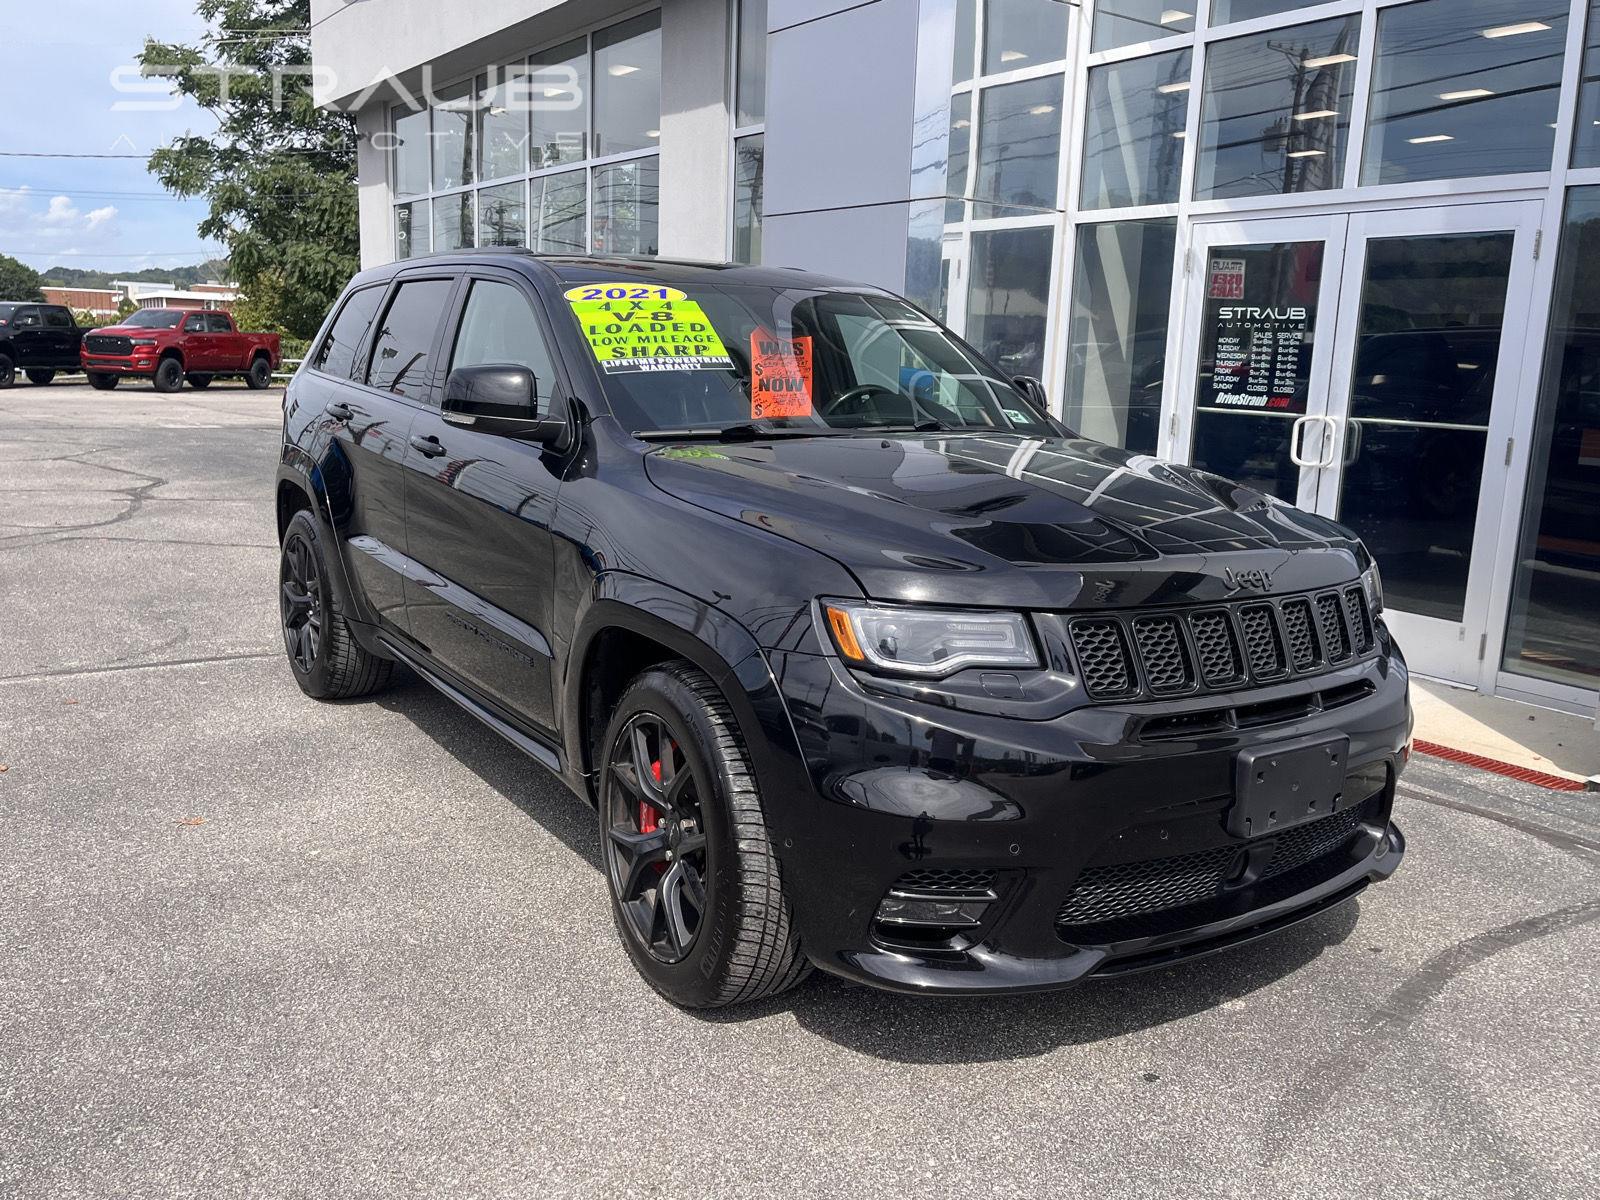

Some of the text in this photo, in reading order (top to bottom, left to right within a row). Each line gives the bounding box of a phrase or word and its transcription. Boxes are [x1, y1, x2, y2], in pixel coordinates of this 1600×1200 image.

[582, 288, 668, 300] 2021
[613, 312, 673, 322] V-8
[1219, 308, 1306, 320] STRAUB
[589, 323, 706, 336] LOADED
[1253, 331, 1303, 340] SALES SERVICE
[592, 334, 715, 347] LOW MILEAGE
[611, 345, 709, 358] SHARP
[759, 341, 804, 355] WAS
[603, 355, 731, 367] LIFETIME POWERTRAIN
[639, 363, 701, 371] WARRANTY
[758, 377, 804, 392] NOW
[1216, 392, 1290, 408] DriveStraub.com
[1223, 566, 1273, 592] Jeep
